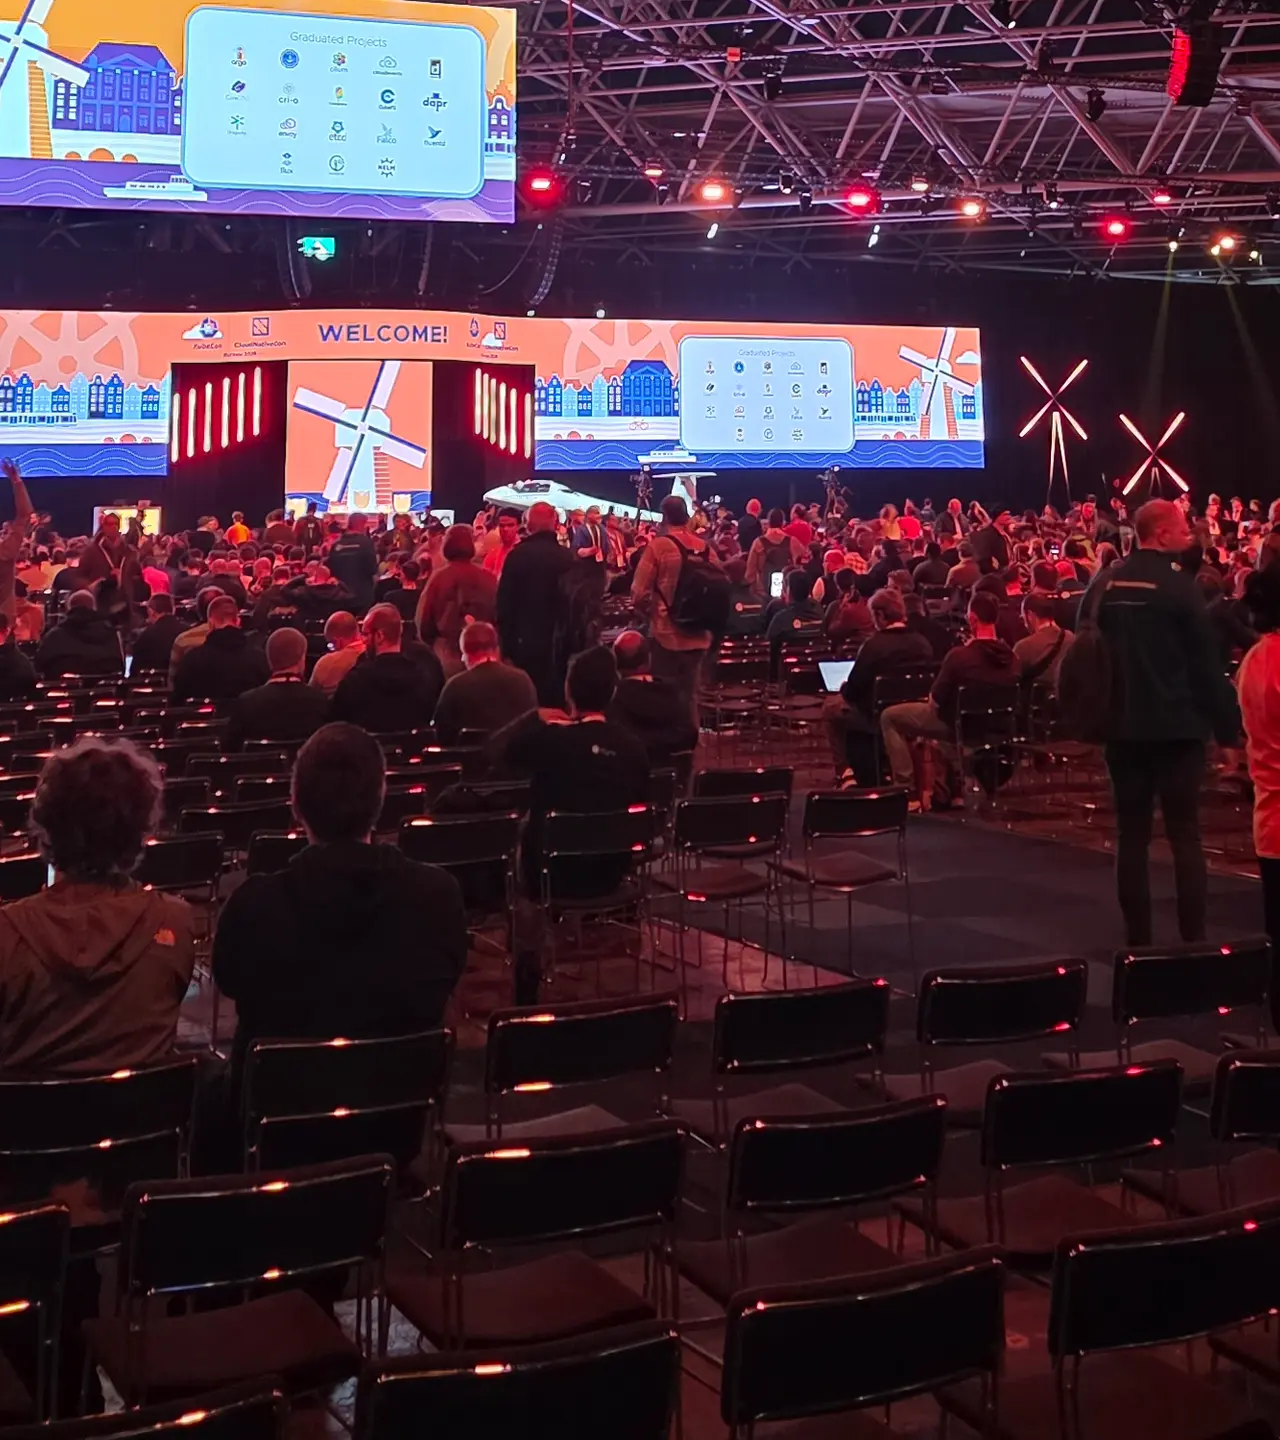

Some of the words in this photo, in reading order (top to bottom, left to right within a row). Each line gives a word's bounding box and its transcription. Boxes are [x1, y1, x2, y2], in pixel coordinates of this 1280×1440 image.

[290, 31, 344, 45] Graduated
[347, 35, 387, 48] Projects
[231, 59, 247, 67] argo
[422, 97, 448, 112] dapr
[328, 133, 347, 141] etcd
[318, 324, 448, 343] WELCOME!
